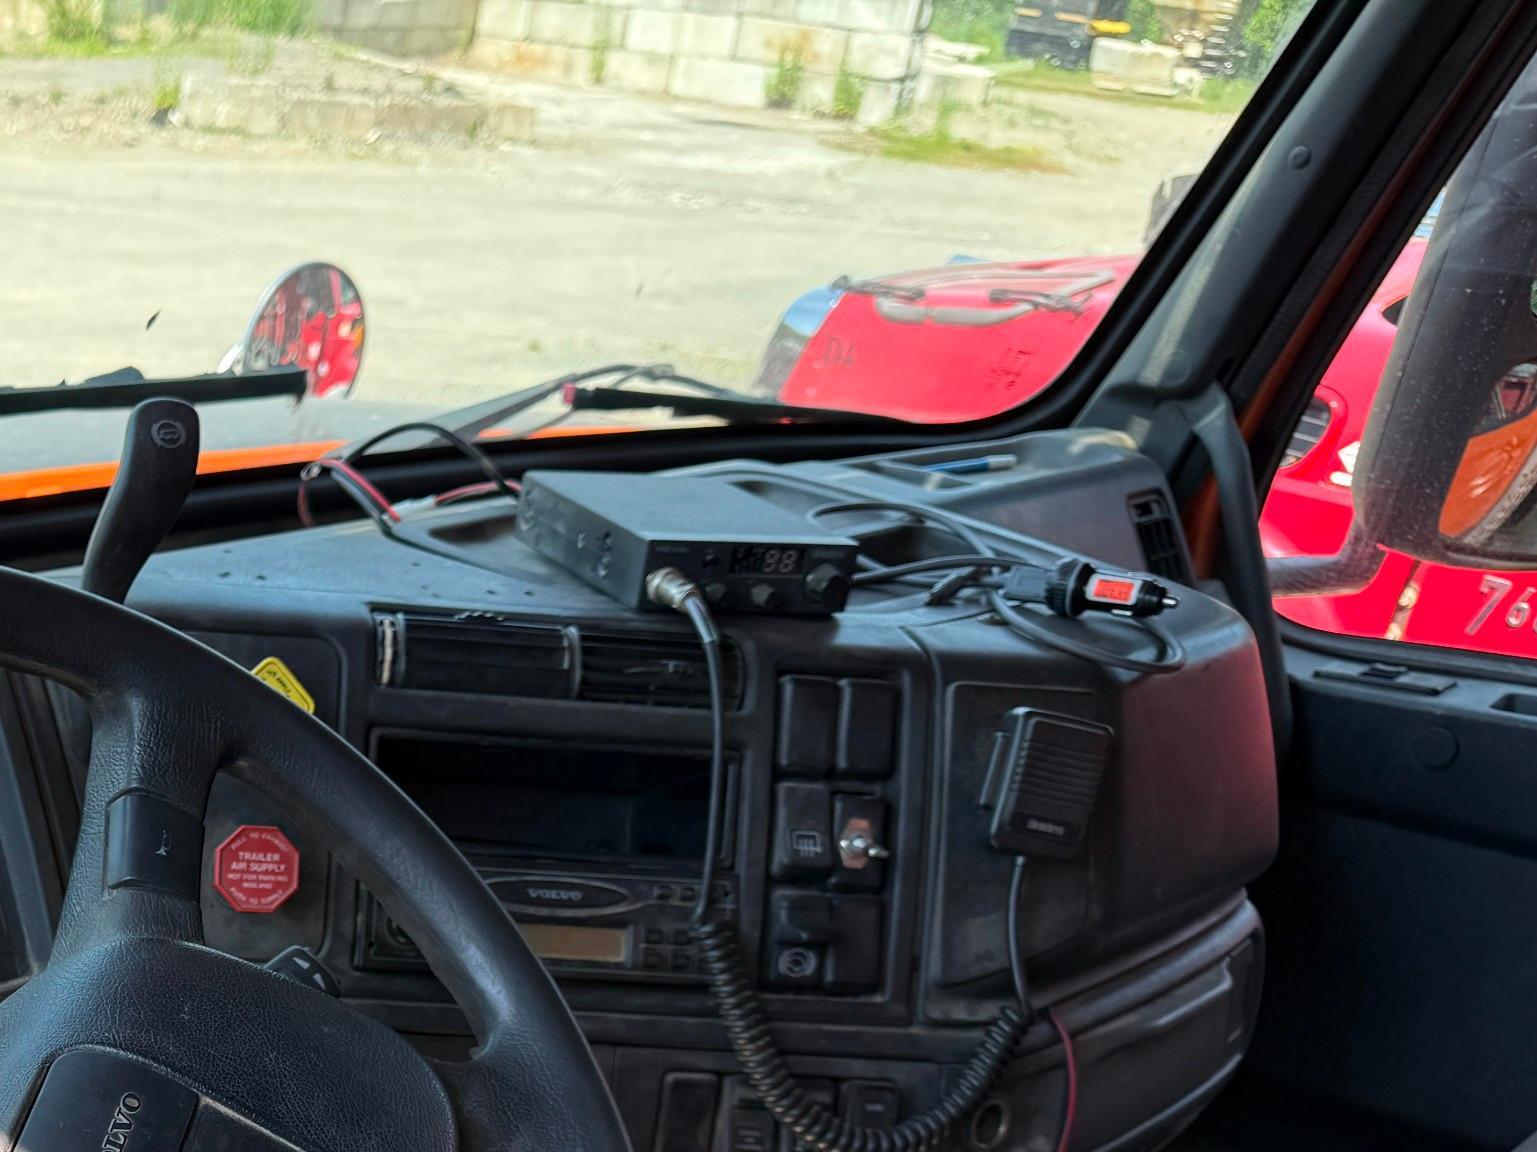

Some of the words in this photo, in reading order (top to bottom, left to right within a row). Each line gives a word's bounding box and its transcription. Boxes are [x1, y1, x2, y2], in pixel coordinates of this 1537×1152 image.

[1465, 575, 1537, 635] 76
[238, 851, 280, 862] TRAILER
[249, 862, 287, 873] SUPPLY
[525, 887, 585, 901] VOLVO
